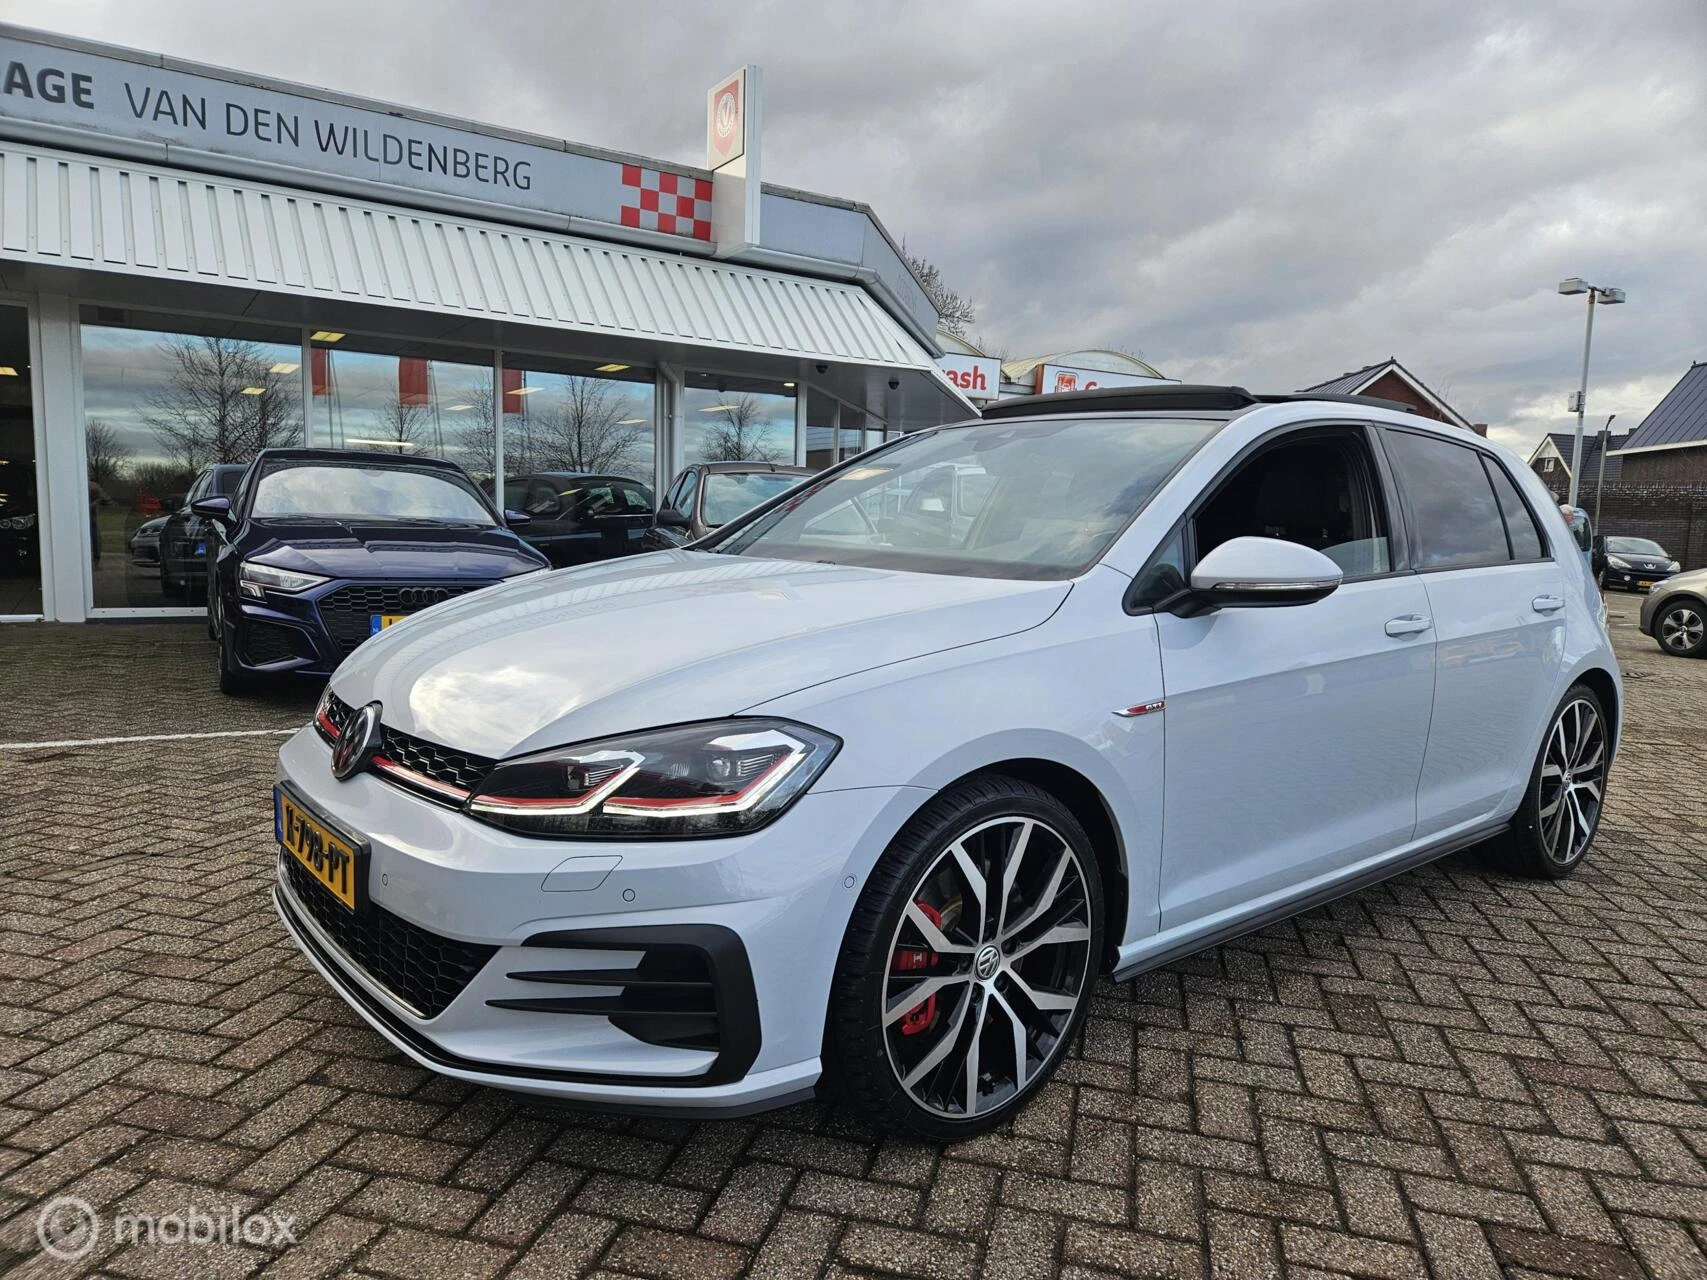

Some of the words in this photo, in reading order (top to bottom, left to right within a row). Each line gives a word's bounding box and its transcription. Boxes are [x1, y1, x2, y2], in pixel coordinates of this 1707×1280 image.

[124, 82, 207, 130] VAN
[225, 102, 299, 147] DEN
[313, 119, 532, 190] WILDENBERG
[942, 365, 986, 390] ash
